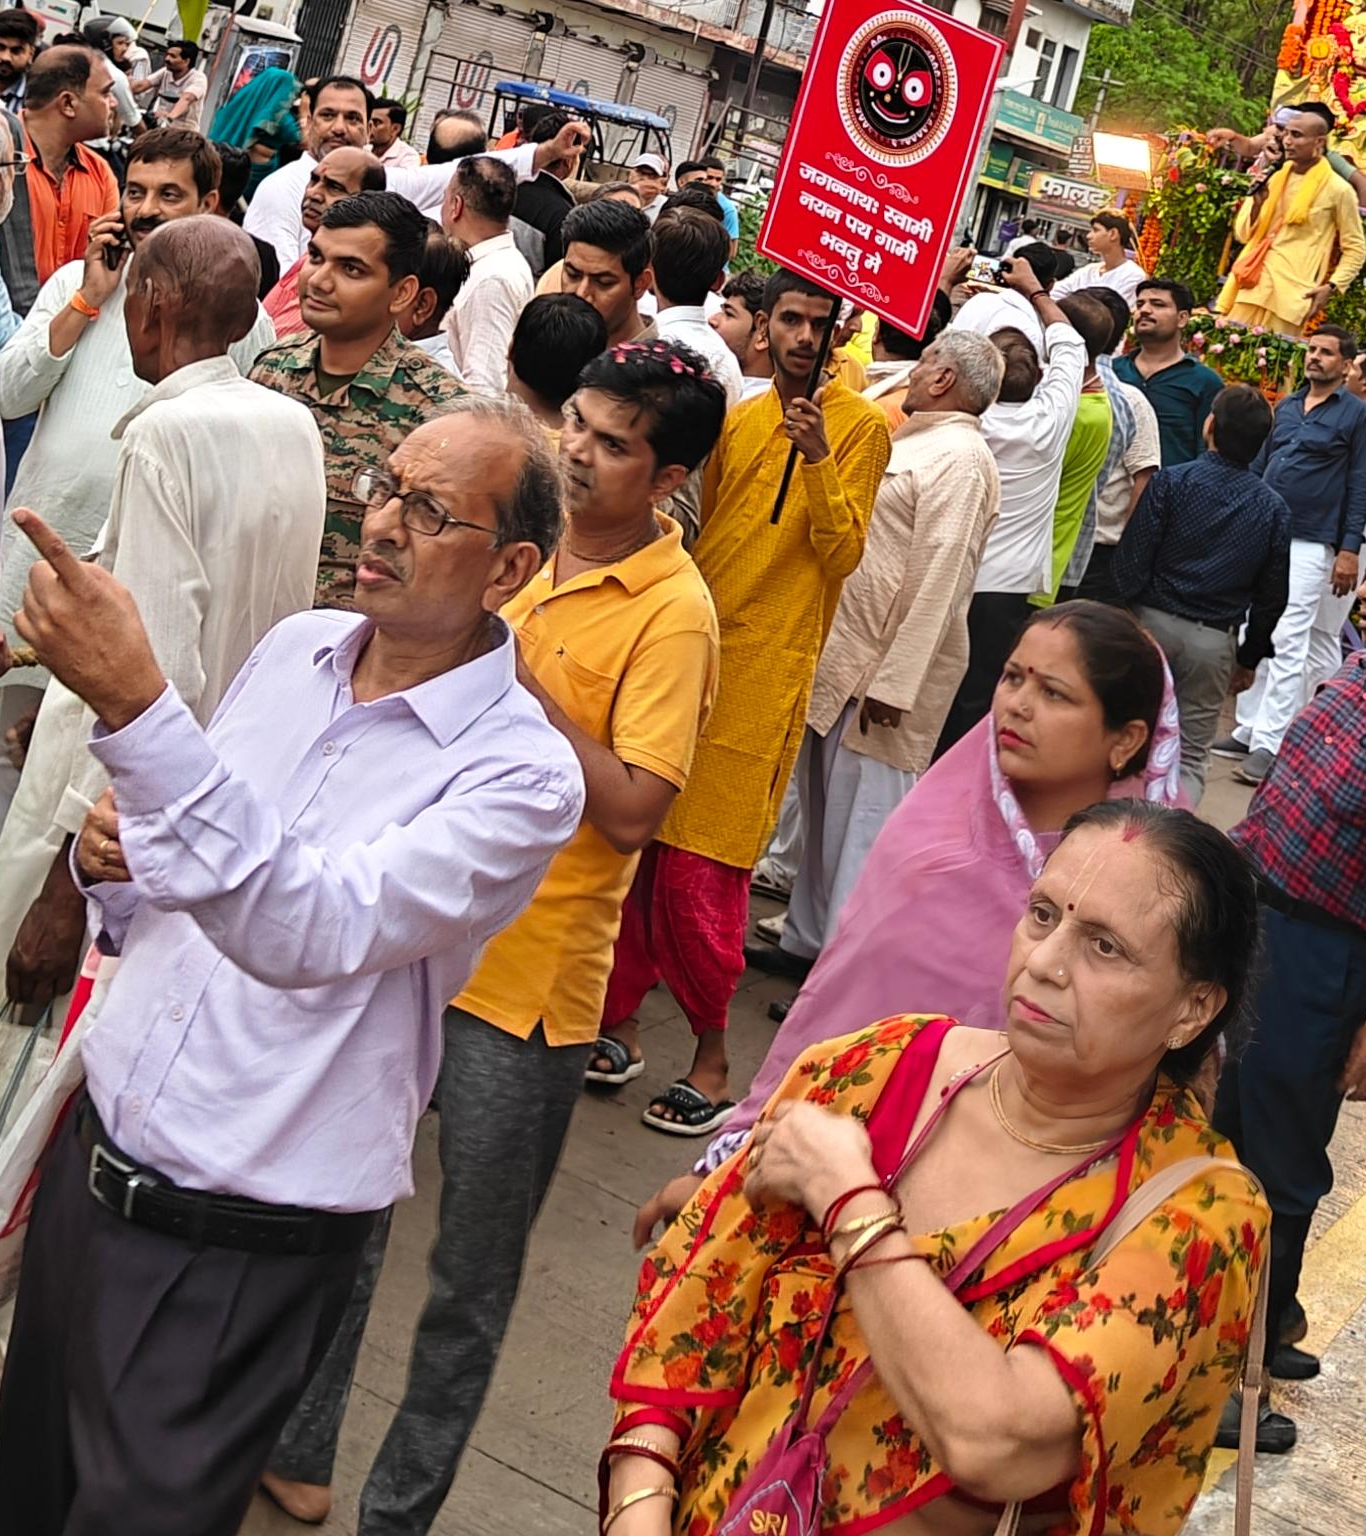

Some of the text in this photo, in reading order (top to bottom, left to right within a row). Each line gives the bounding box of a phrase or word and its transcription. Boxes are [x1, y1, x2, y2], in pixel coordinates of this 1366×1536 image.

[1077, 137, 1092, 146] TO
[799, 191, 919, 264] नयन पथ गामी
[884, 205, 934, 243] स्वामी
[820, 231, 883, 275] भवतु मे
[750, 1509, 788, 1536] SRI
